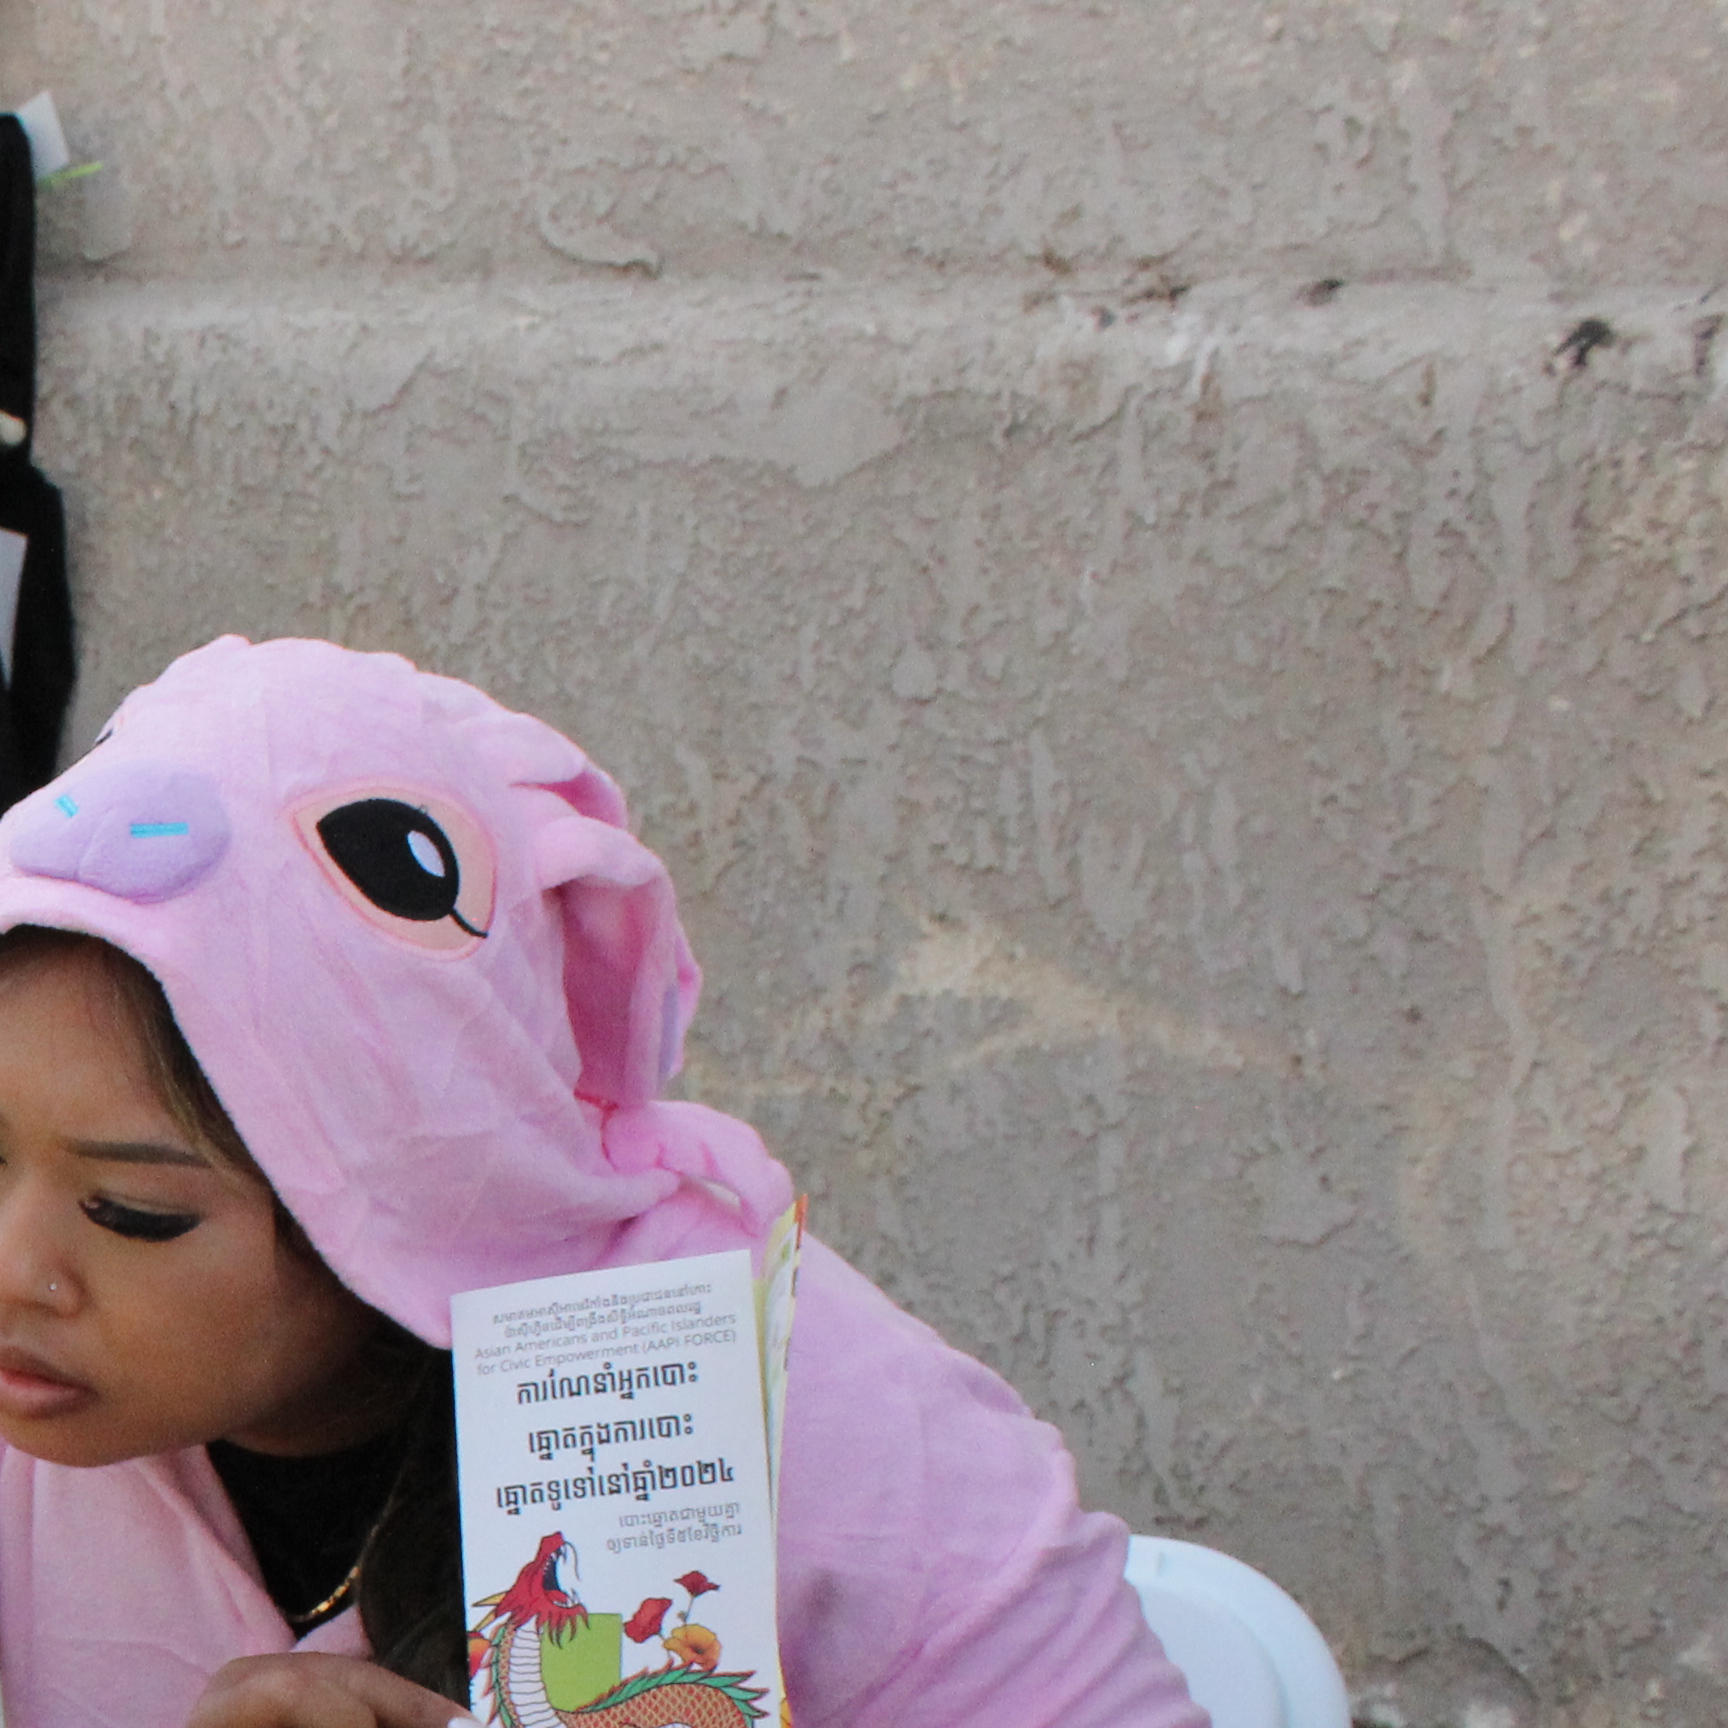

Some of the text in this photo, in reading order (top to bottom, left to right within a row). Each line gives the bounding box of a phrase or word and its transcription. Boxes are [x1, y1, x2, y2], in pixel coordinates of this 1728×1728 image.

[474, 1313, 737, 1360] Asian Americans and Pacific Islanders
[477, 1362, 498, 1376] for
[500, 1357, 531, 1373] Civic
[534, 1345, 640, 1369] Empowerment
